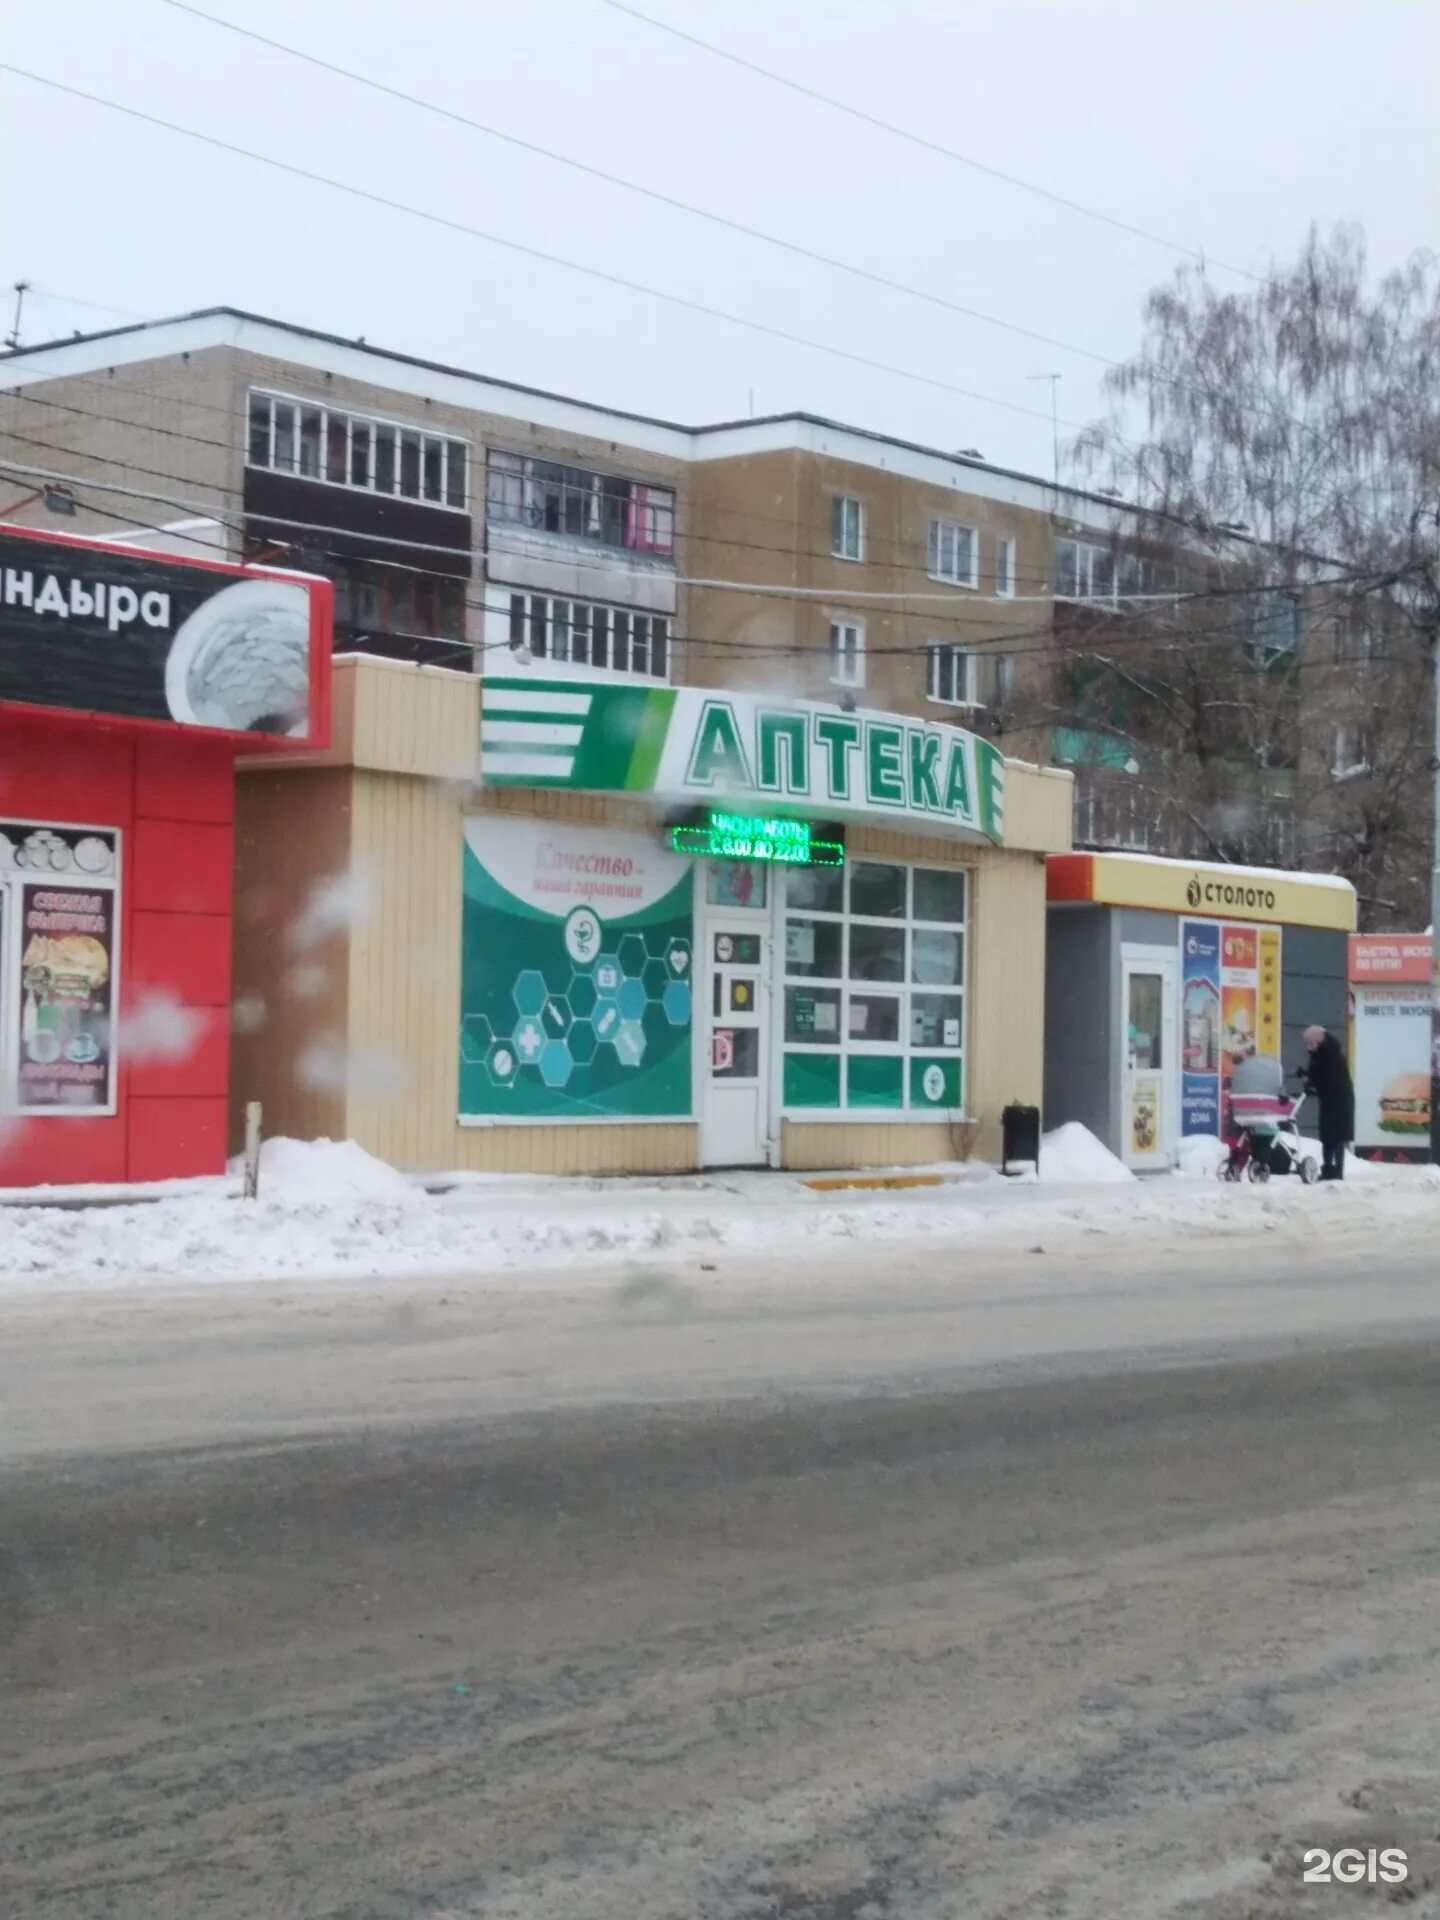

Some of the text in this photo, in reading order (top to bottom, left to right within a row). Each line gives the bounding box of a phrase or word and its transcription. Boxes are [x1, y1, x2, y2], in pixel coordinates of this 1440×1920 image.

[0, 567, 171, 631] ндыра
[684, 699, 973, 822] АПТЕКА
[1205, 883, 1275, 910] СТОЛОТО
